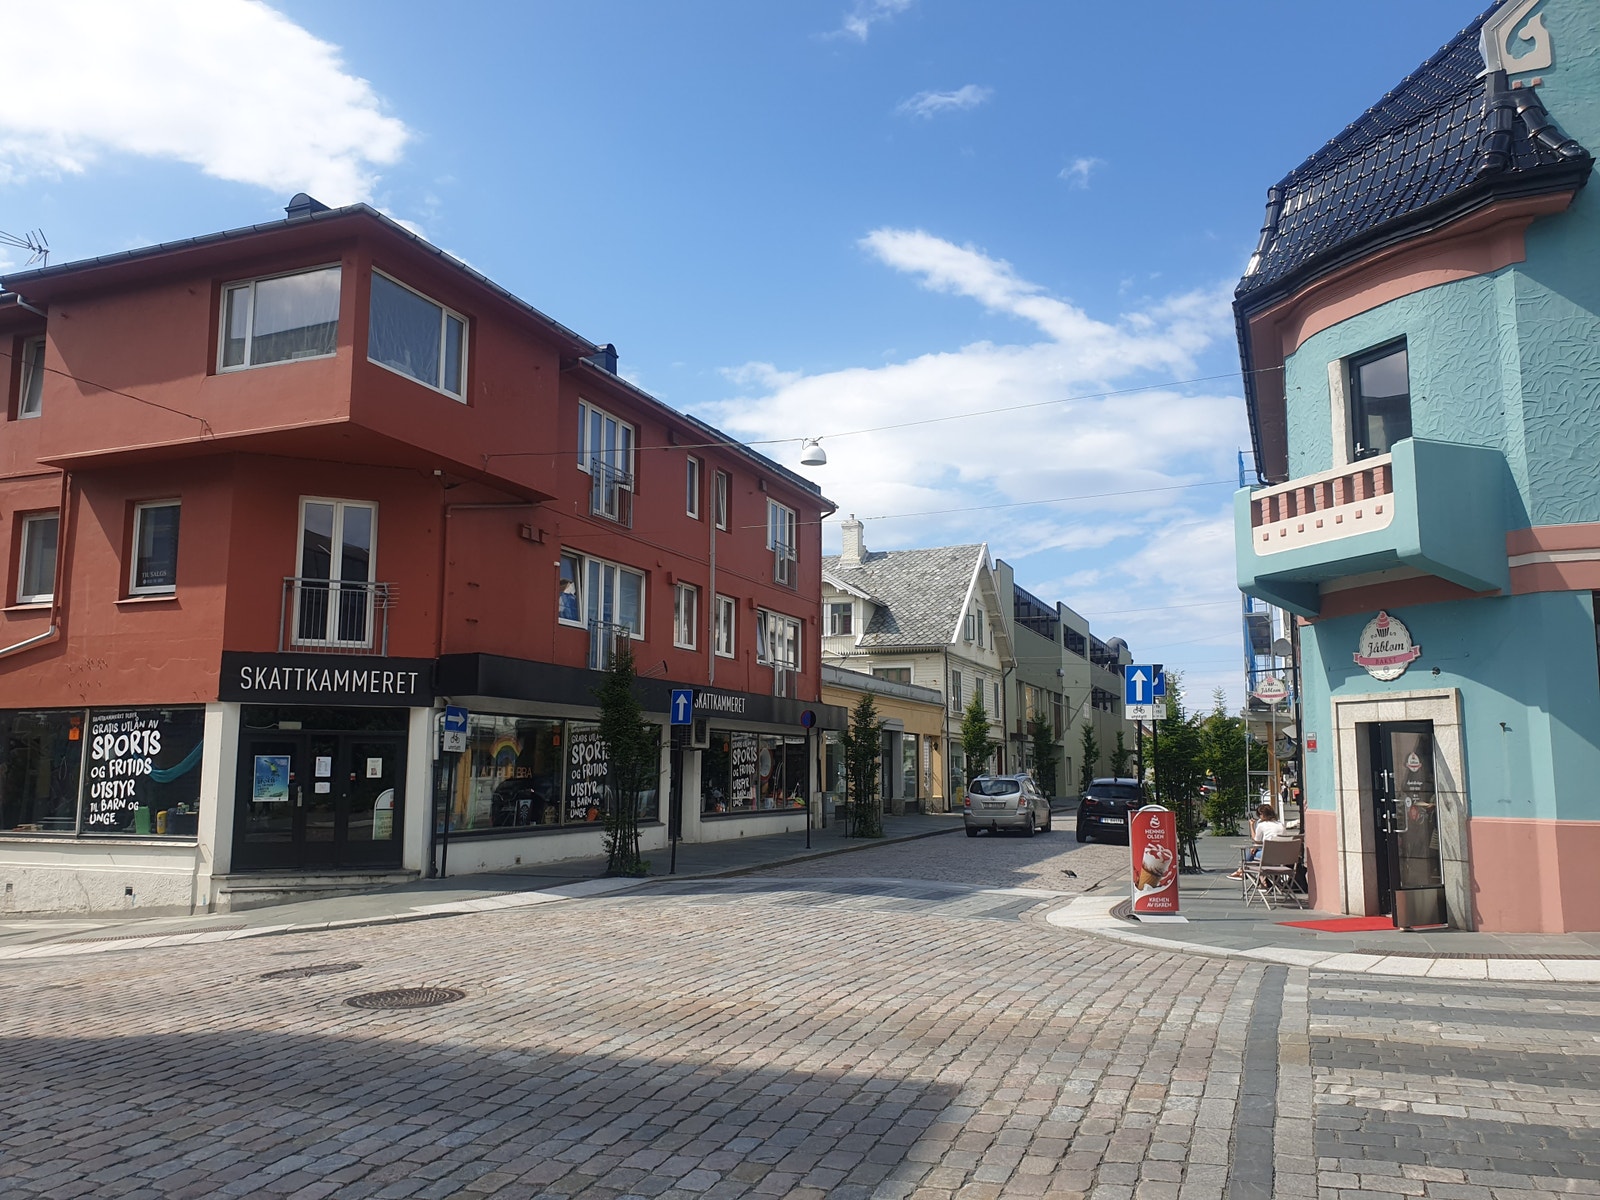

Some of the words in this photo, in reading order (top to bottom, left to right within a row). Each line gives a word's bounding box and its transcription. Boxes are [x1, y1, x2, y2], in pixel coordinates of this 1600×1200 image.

[1367, 640, 1404, 657] Jåblom
[240, 666, 418, 694] SKATTKAMMERET
[92, 722, 119, 735] GRATIS
[121, 716, 146, 732] UTLÅN
[148, 719, 159, 729] AV
[92, 730, 161, 762] SPORTS
[732, 746, 758, 766] SPORTS
[91, 766, 106, 778] OG
[109, 757, 152, 779] FRITIDS
[571, 769, 581, 779] OG
[582, 762, 608, 779] FRITIDS
[91, 779, 135, 799] UTSTYR
[570, 780, 598, 797] UTSTYR
[101, 798, 126, 811] BARN
[128, 801, 139, 811] OG
[576, 796, 592, 807] BARN
[89, 812, 117, 825] UNGE.
